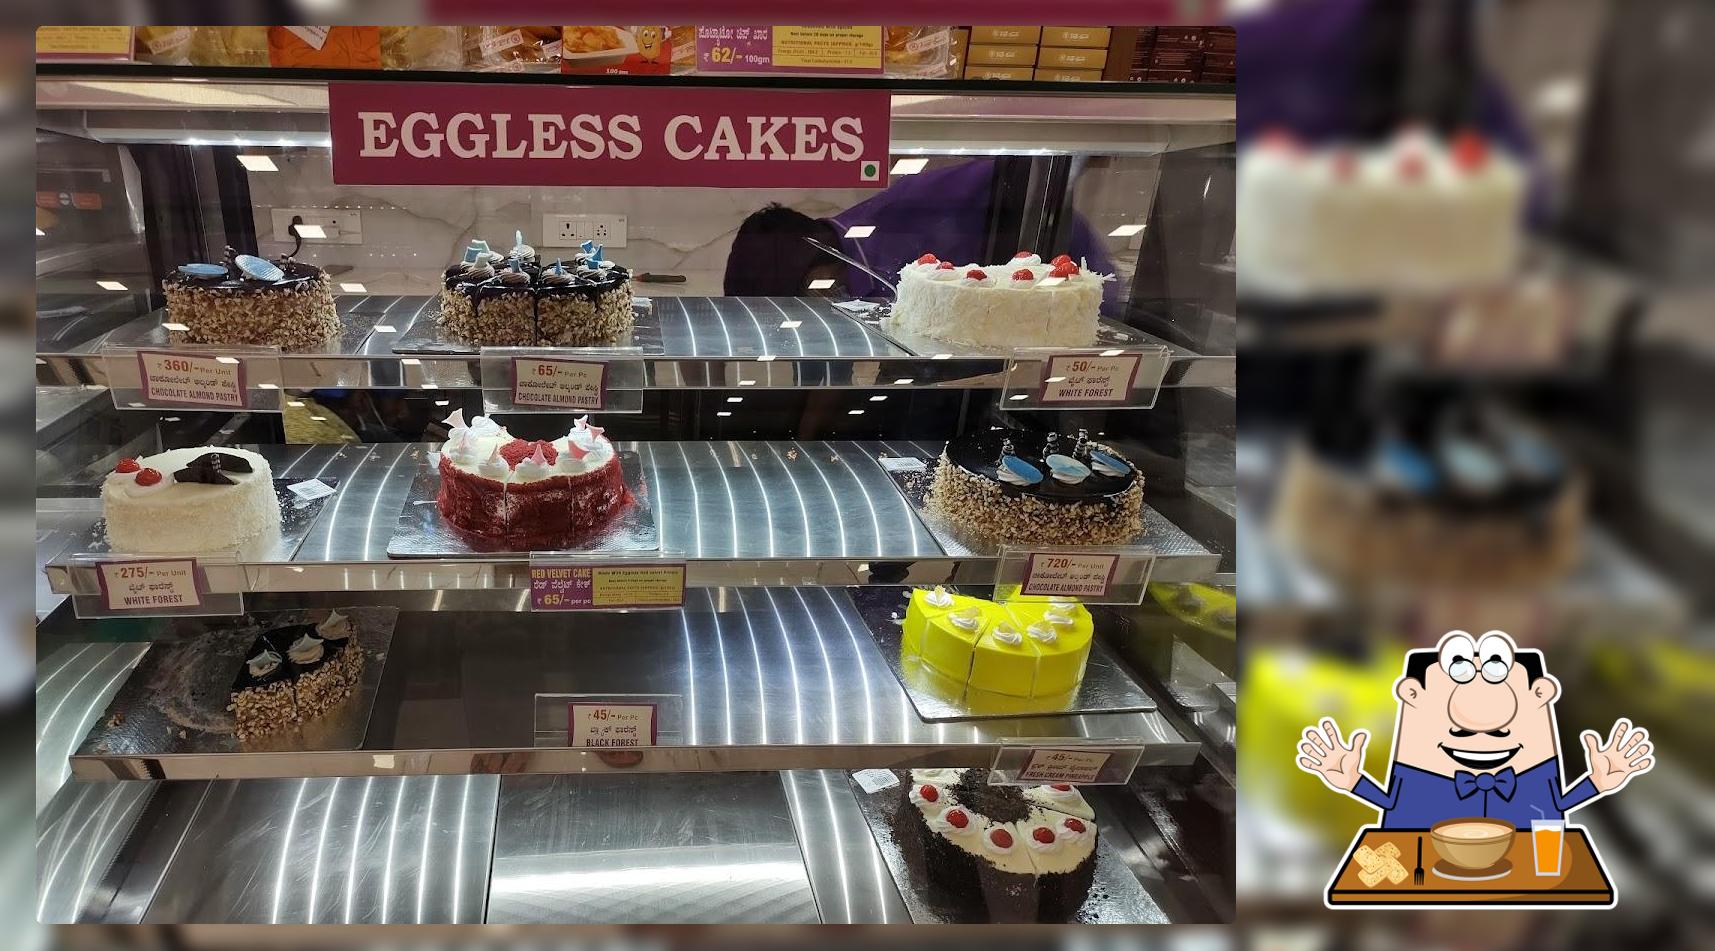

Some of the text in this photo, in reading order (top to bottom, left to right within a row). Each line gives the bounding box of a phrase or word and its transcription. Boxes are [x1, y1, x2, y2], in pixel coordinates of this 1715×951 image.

[745, 55, 770, 65] 100gm
[358, 111, 864, 161] EGGLESS CAKES
[151, 387, 238, 402] CHOCOLATE ALMOND PASTRY
[518, 392, 598, 404] CHOCOLATE ALMOND PASTRY
[1059, 389, 1114, 397] WHITE FOREST
[171, 569, 186, 577] Unit
[531, 568, 591, 578] RED VELVET CAKE
[1028, 583, 1060, 591] CHOCOLATE
[1060, 584, 1083, 592] ALMOND
[124, 594, 183, 606] WHITE FOREST
[586, 739, 638, 747] BLACK FOREST
